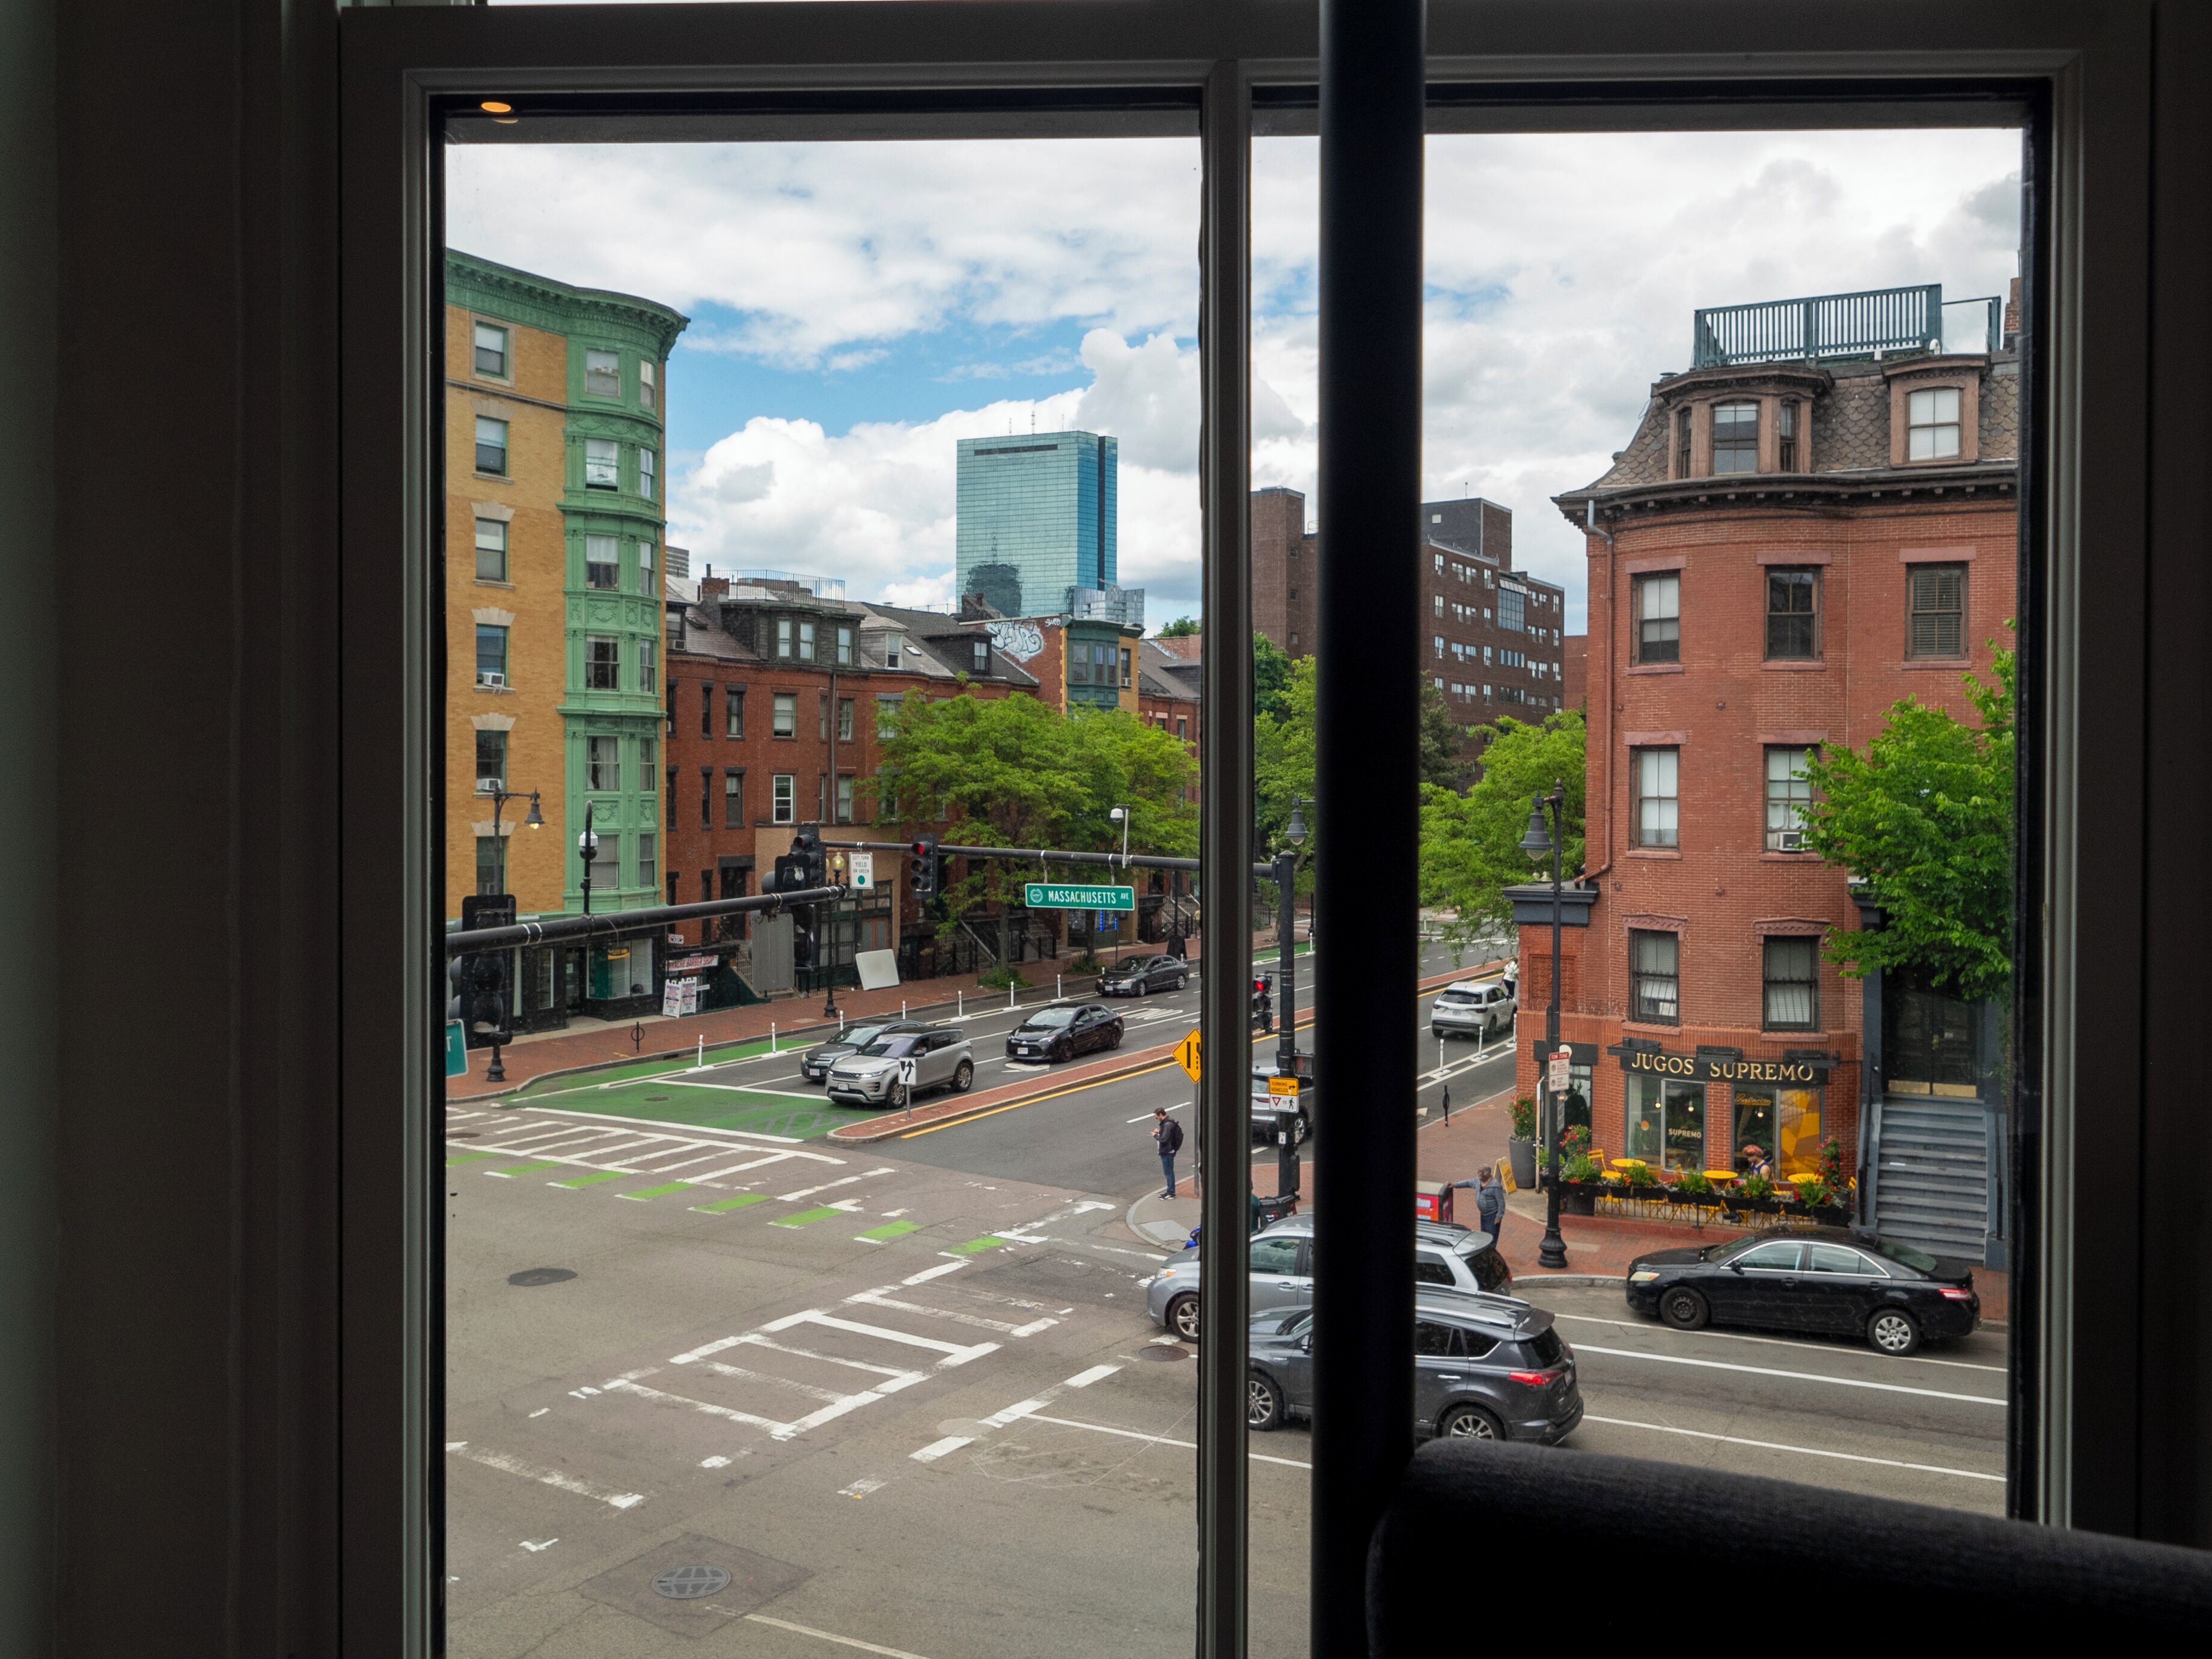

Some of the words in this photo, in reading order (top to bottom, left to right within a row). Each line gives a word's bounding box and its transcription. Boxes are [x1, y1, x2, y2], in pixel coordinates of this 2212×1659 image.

[1048, 890, 1116, 904] MASSACHUSETTS
[1631, 1053, 1694, 1075] JUGOS
[1710, 1062, 1813, 1081] SUPREMO
[1668, 1128, 1702, 1139] SUPREMO
